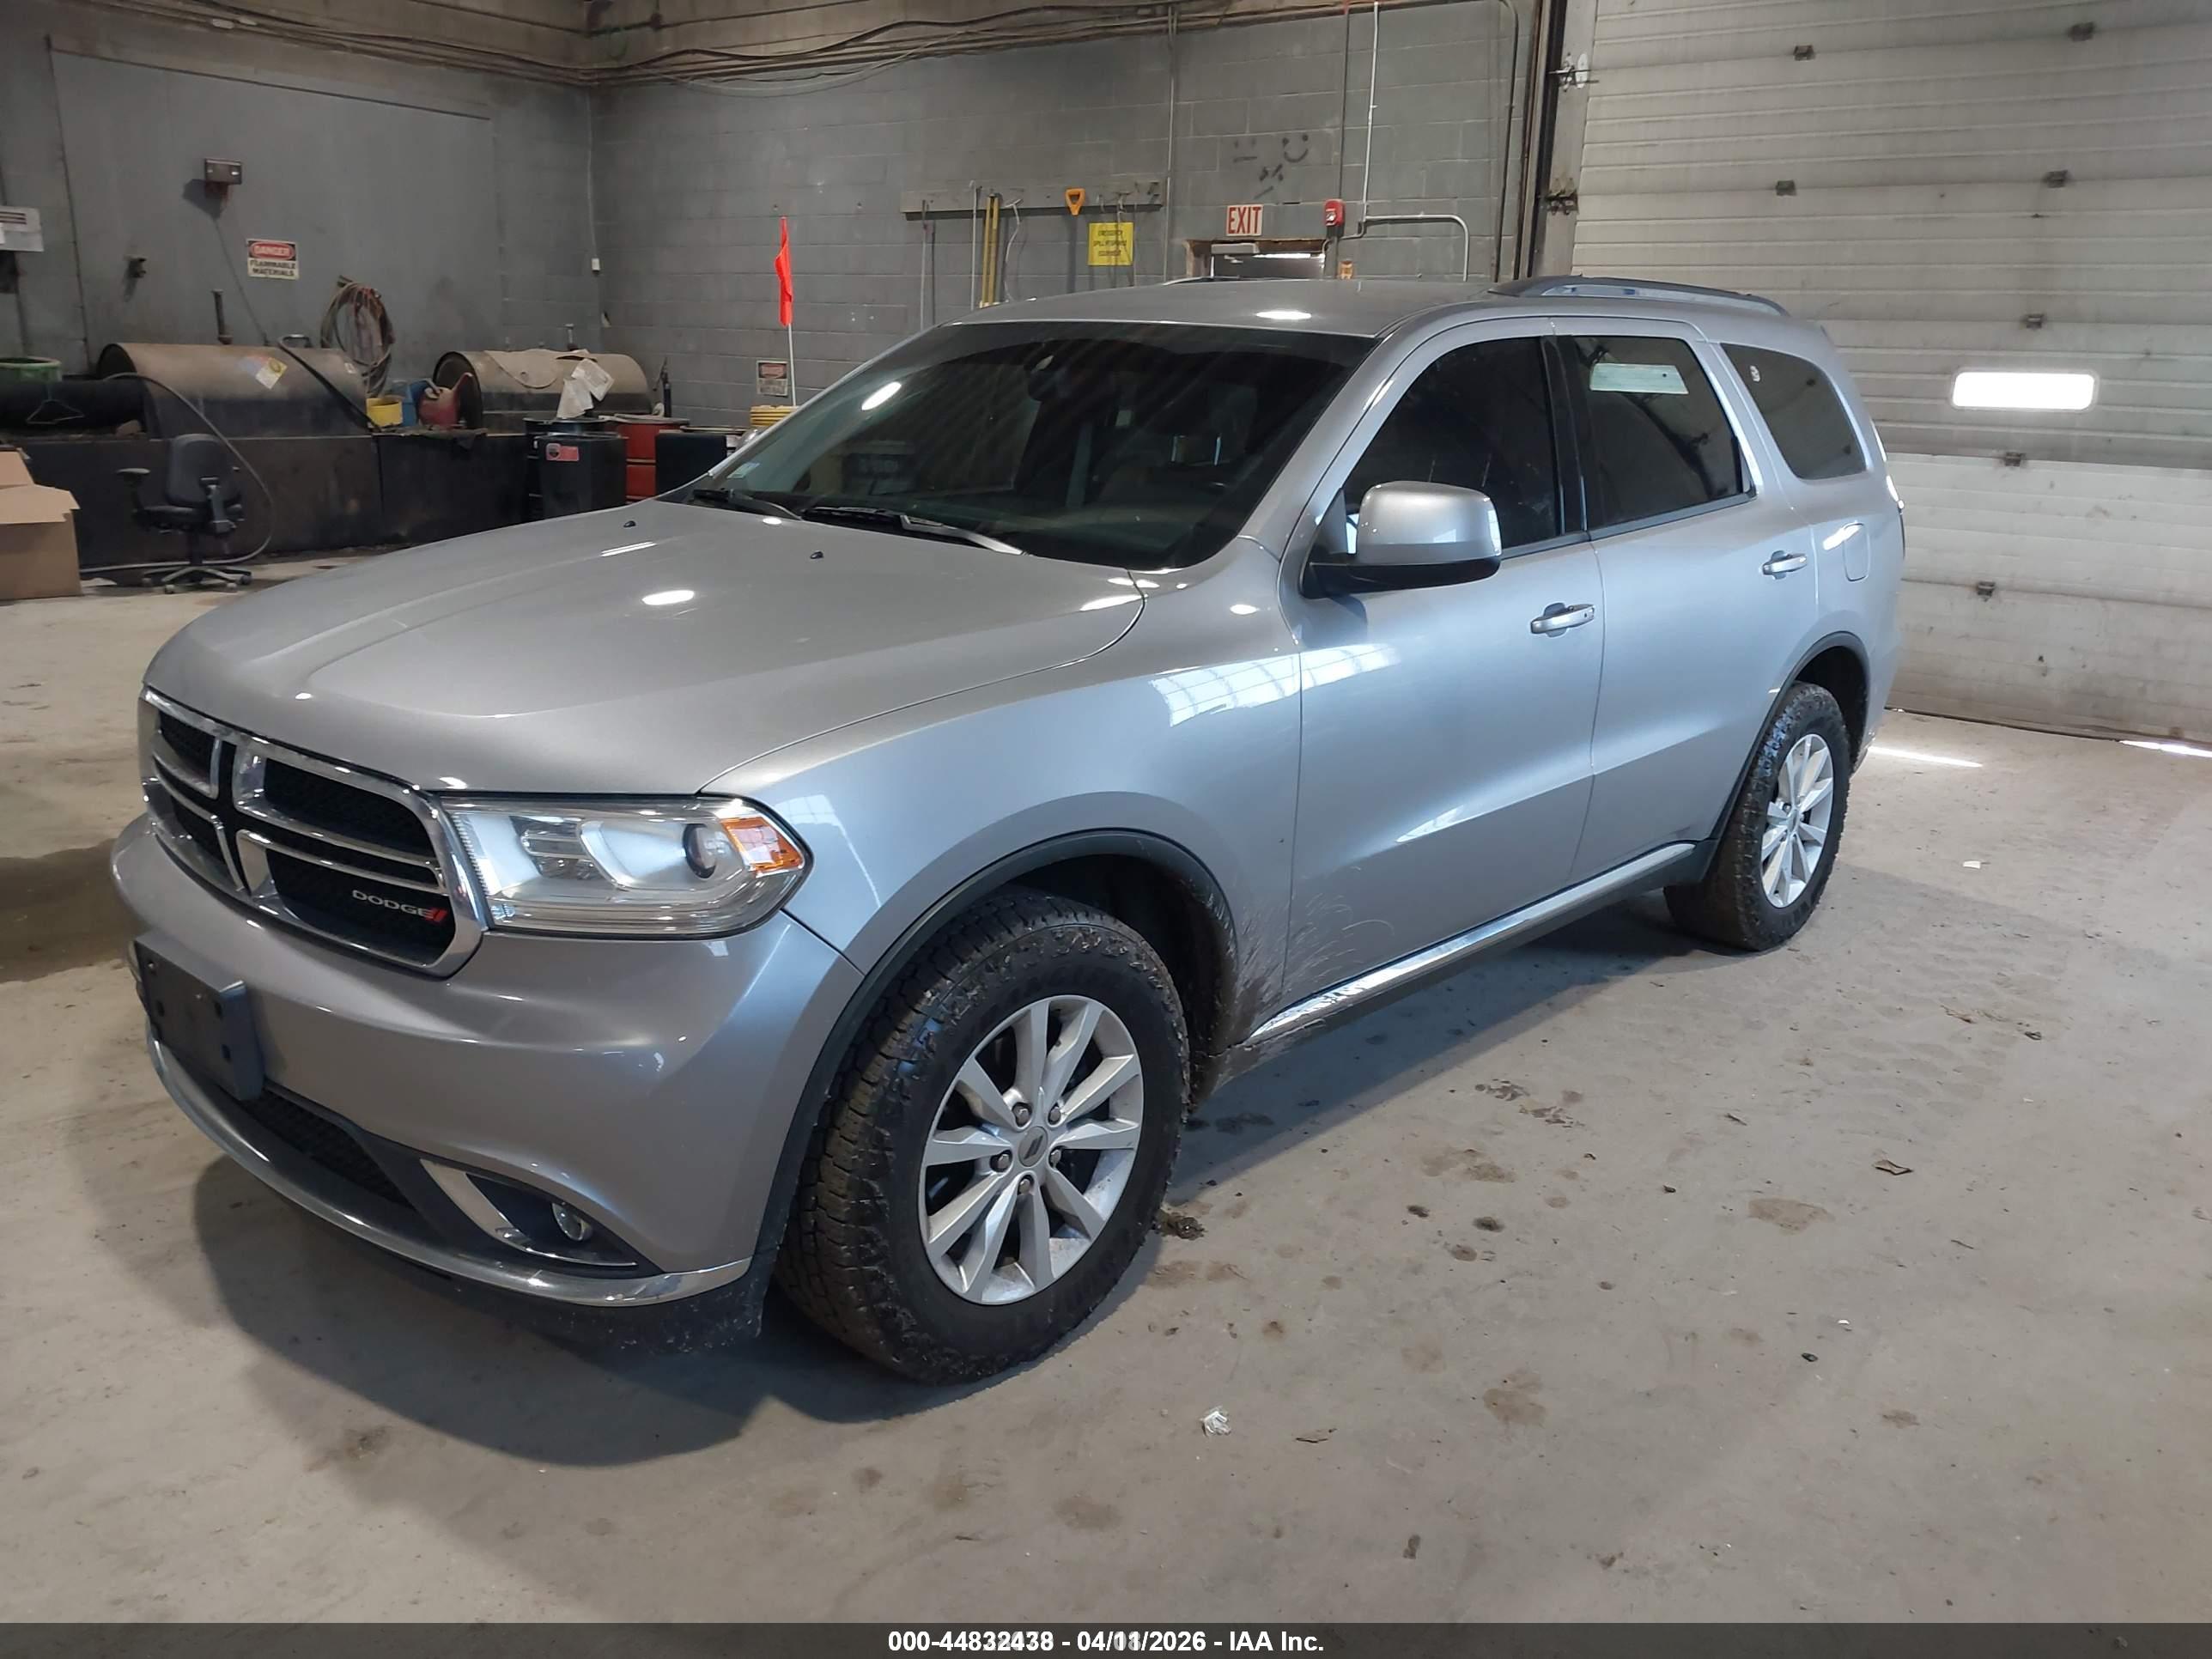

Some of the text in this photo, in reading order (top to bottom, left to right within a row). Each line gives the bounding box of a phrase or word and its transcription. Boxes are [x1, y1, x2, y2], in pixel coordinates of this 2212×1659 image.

[1228, 206, 1261, 234] EXIT
[253, 246, 290, 256] DANGER
[252, 267, 295, 276] MATERIALS
[352, 890, 434, 919] DODGE
